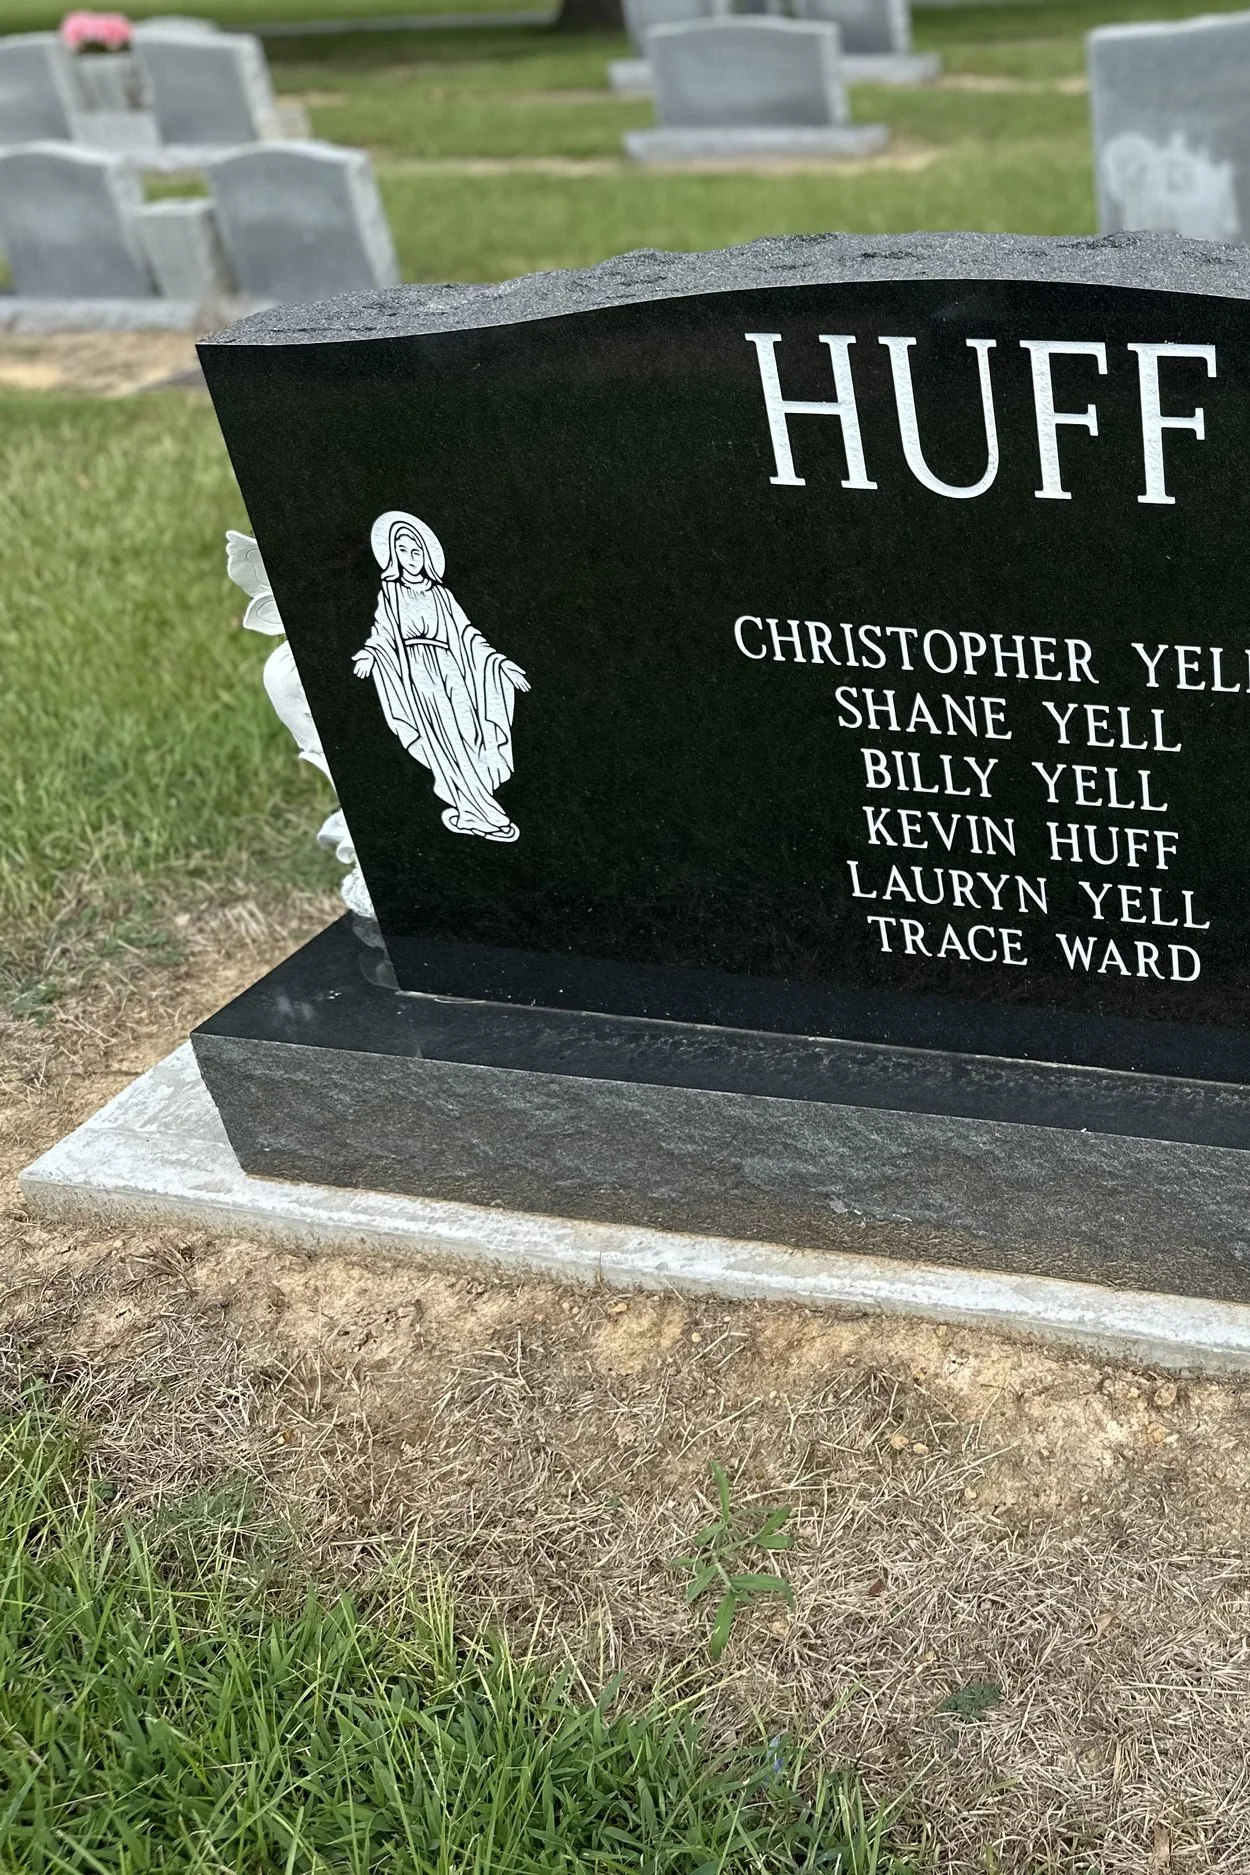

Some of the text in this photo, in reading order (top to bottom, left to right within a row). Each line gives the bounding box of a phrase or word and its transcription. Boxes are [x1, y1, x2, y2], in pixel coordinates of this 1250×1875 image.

[745, 332, 1218, 505] HUFF
[733, 615, 1100, 685] CHRISTOPHER
[834, 685, 1183, 753] SHANE YELL
[860, 747, 1169, 812] BILLY YELL
[862, 806, 1180, 870] KEVIN HUFF
[846, 860, 1211, 930] LAURYN YELL
[866, 915, 1202, 983] TRACE WARD
